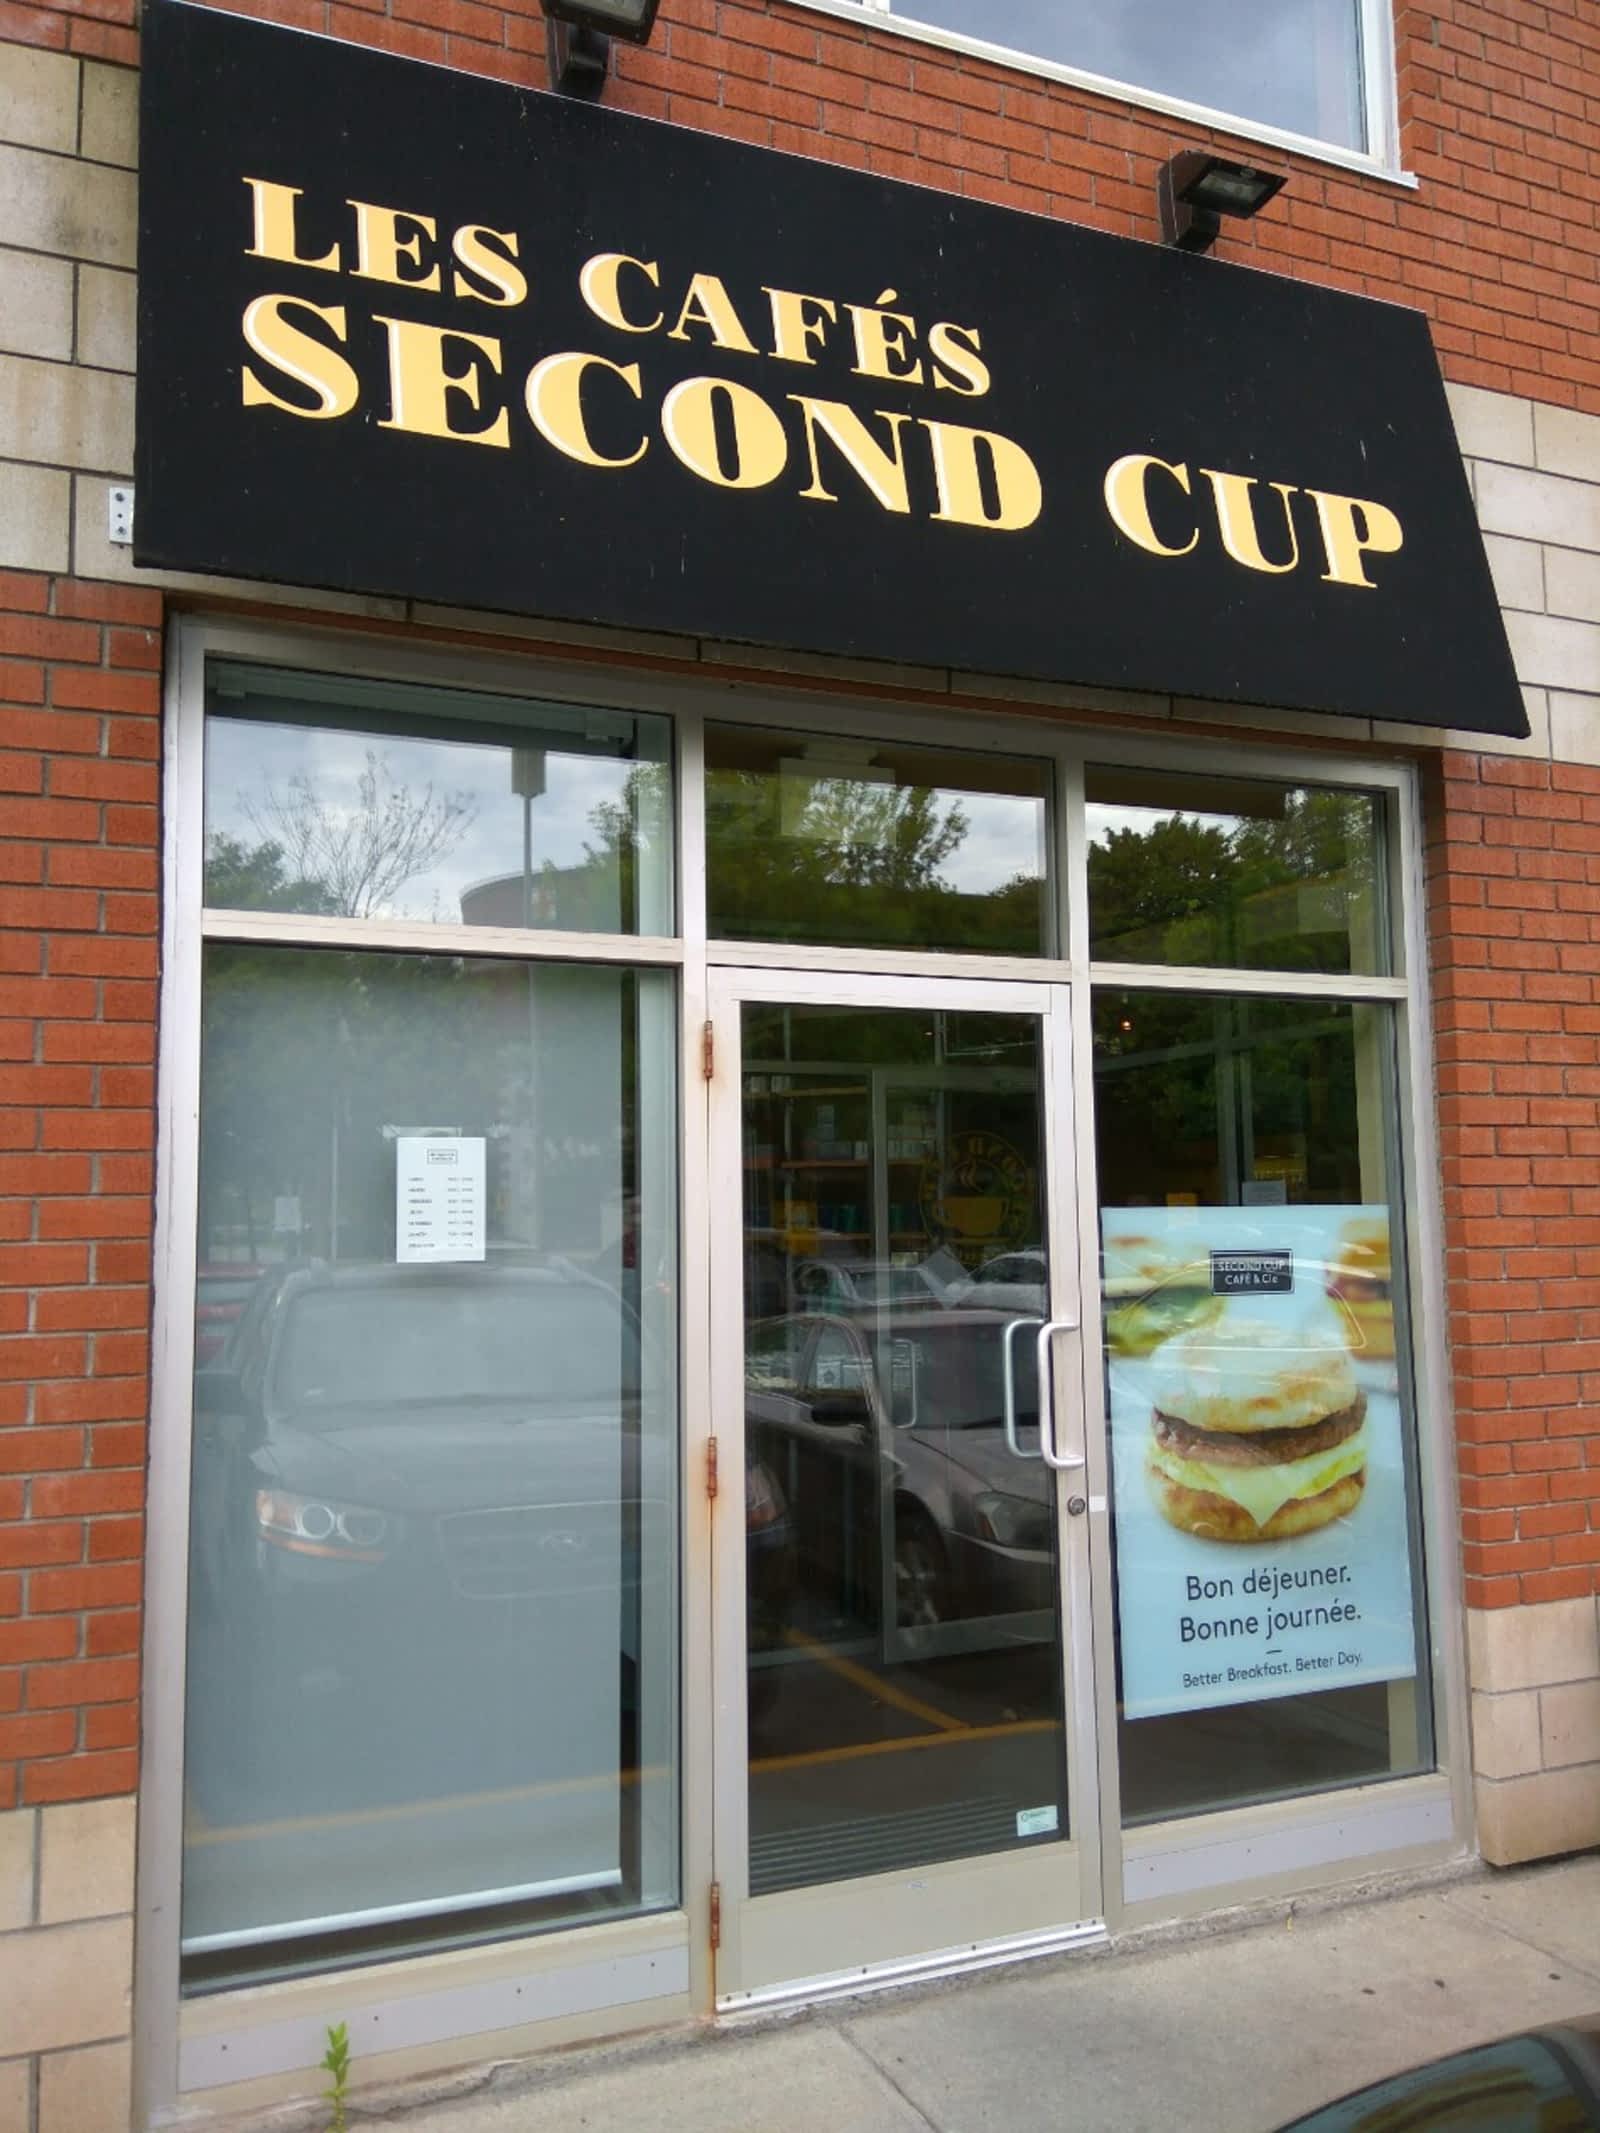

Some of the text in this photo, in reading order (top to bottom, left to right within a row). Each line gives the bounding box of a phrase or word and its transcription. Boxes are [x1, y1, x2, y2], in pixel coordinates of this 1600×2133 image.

[242, 176, 991, 397] LES CAFÉS
[242, 293, 1404, 589] SECOND CUP
[1217, 1259, 1286, 1272] SECOND CUP
[1224, 1272, 1252, 1285] CAFÉ
[1186, 1564, 1352, 1601] Bon déjeuner.
[1179, 1597, 1362, 1643] Bonne journée.
[1182, 1650, 1363, 1688] Better Breakfast. Better Day.
